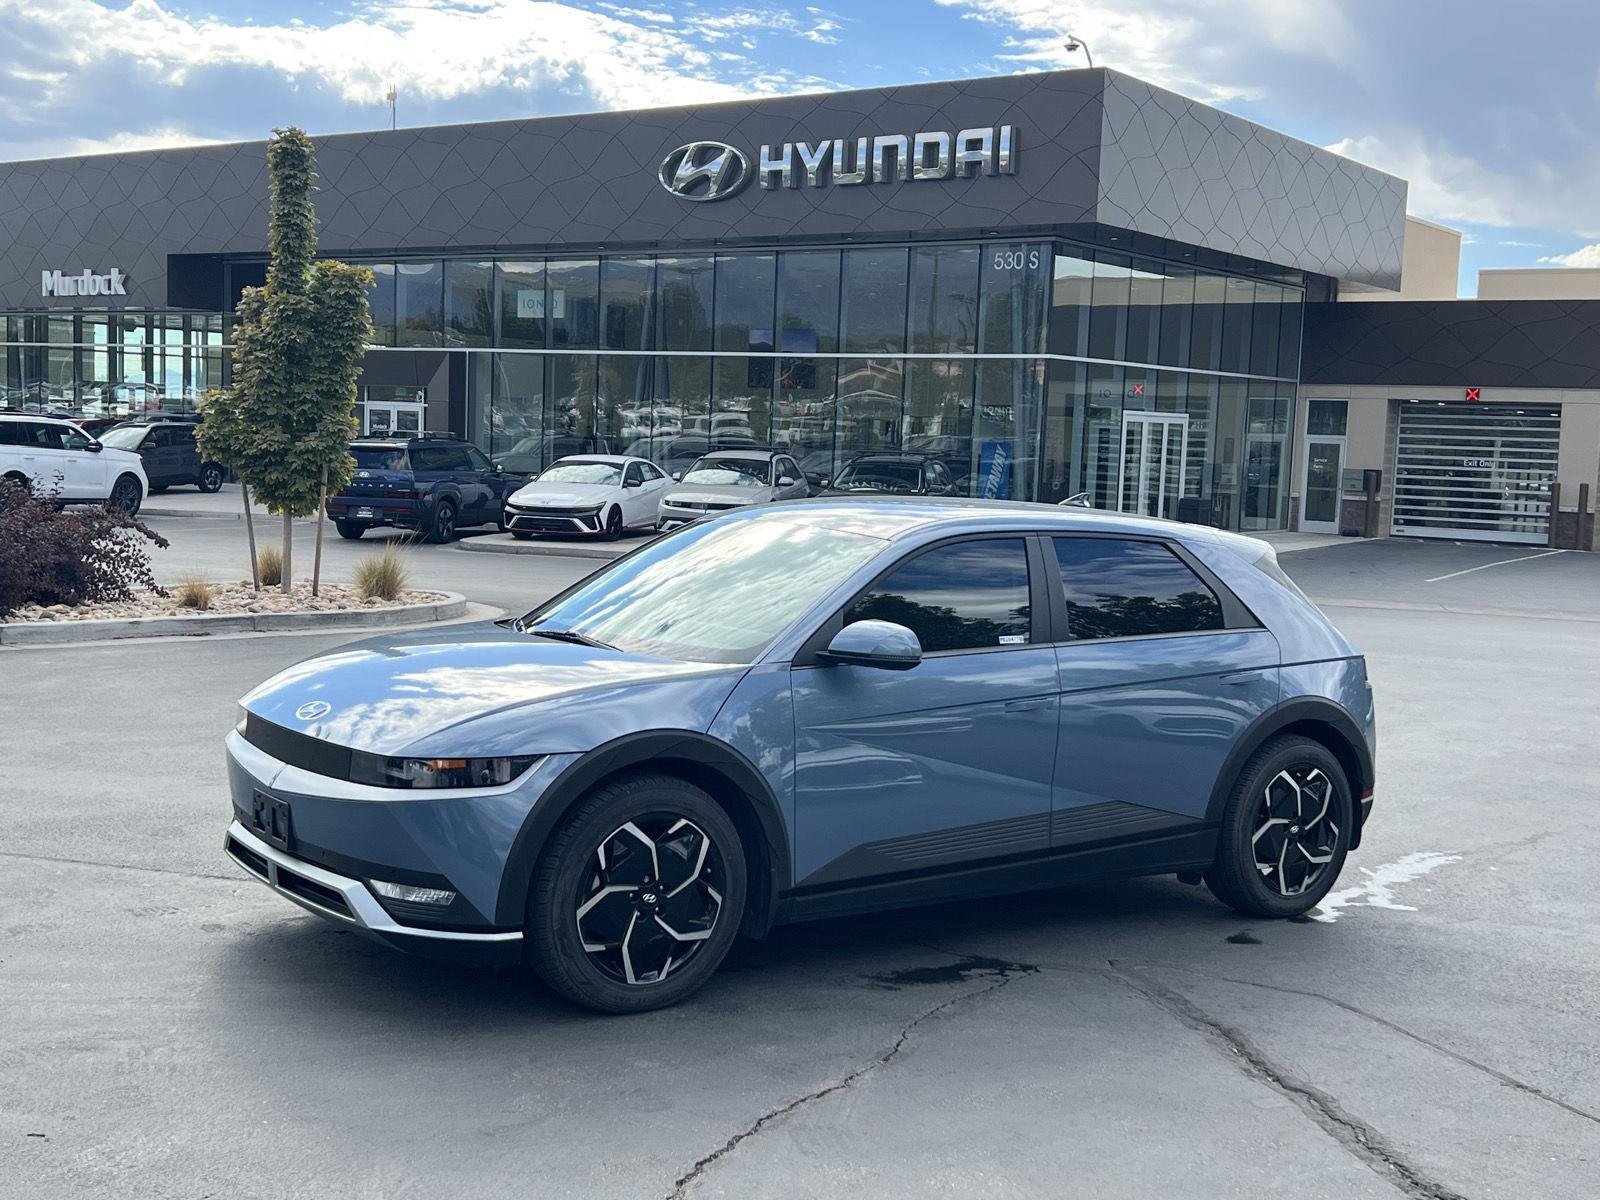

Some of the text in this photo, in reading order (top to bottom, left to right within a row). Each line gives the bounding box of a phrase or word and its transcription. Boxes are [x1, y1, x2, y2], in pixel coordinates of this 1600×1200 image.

[760, 125, 1014, 190] HYUNDAI
[993, 251, 1039, 270] 530 S
[42, 268, 127, 296] Murdock
[984, 444, 1006, 499] ETAWAY
[1463, 459, 1495, 469] Exit Only
